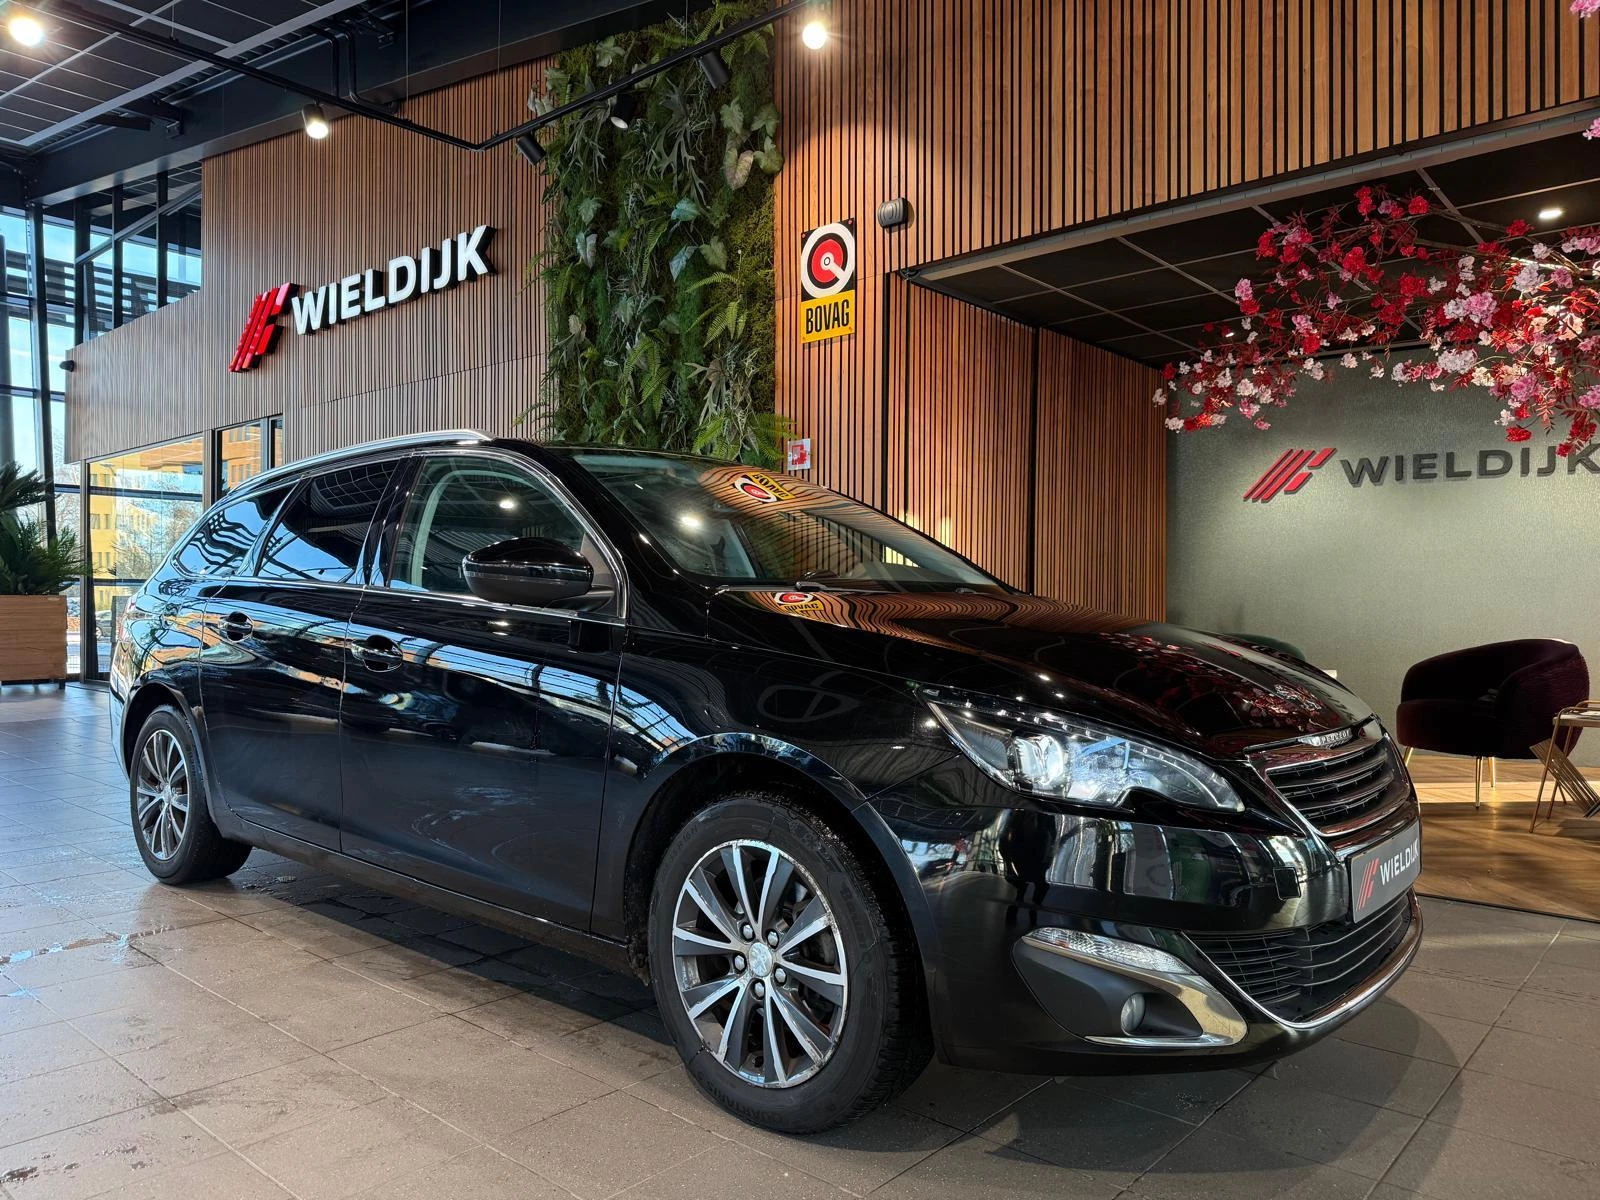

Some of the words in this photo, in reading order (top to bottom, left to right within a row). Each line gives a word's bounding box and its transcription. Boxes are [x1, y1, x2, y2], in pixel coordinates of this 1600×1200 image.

[291, 224, 492, 336] WIELDIJK
[805, 298, 850, 335] BOVAG
[1340, 443, 1600, 487] WIELDIJK
[1379, 838, 1419, 886] WIELDIJK
